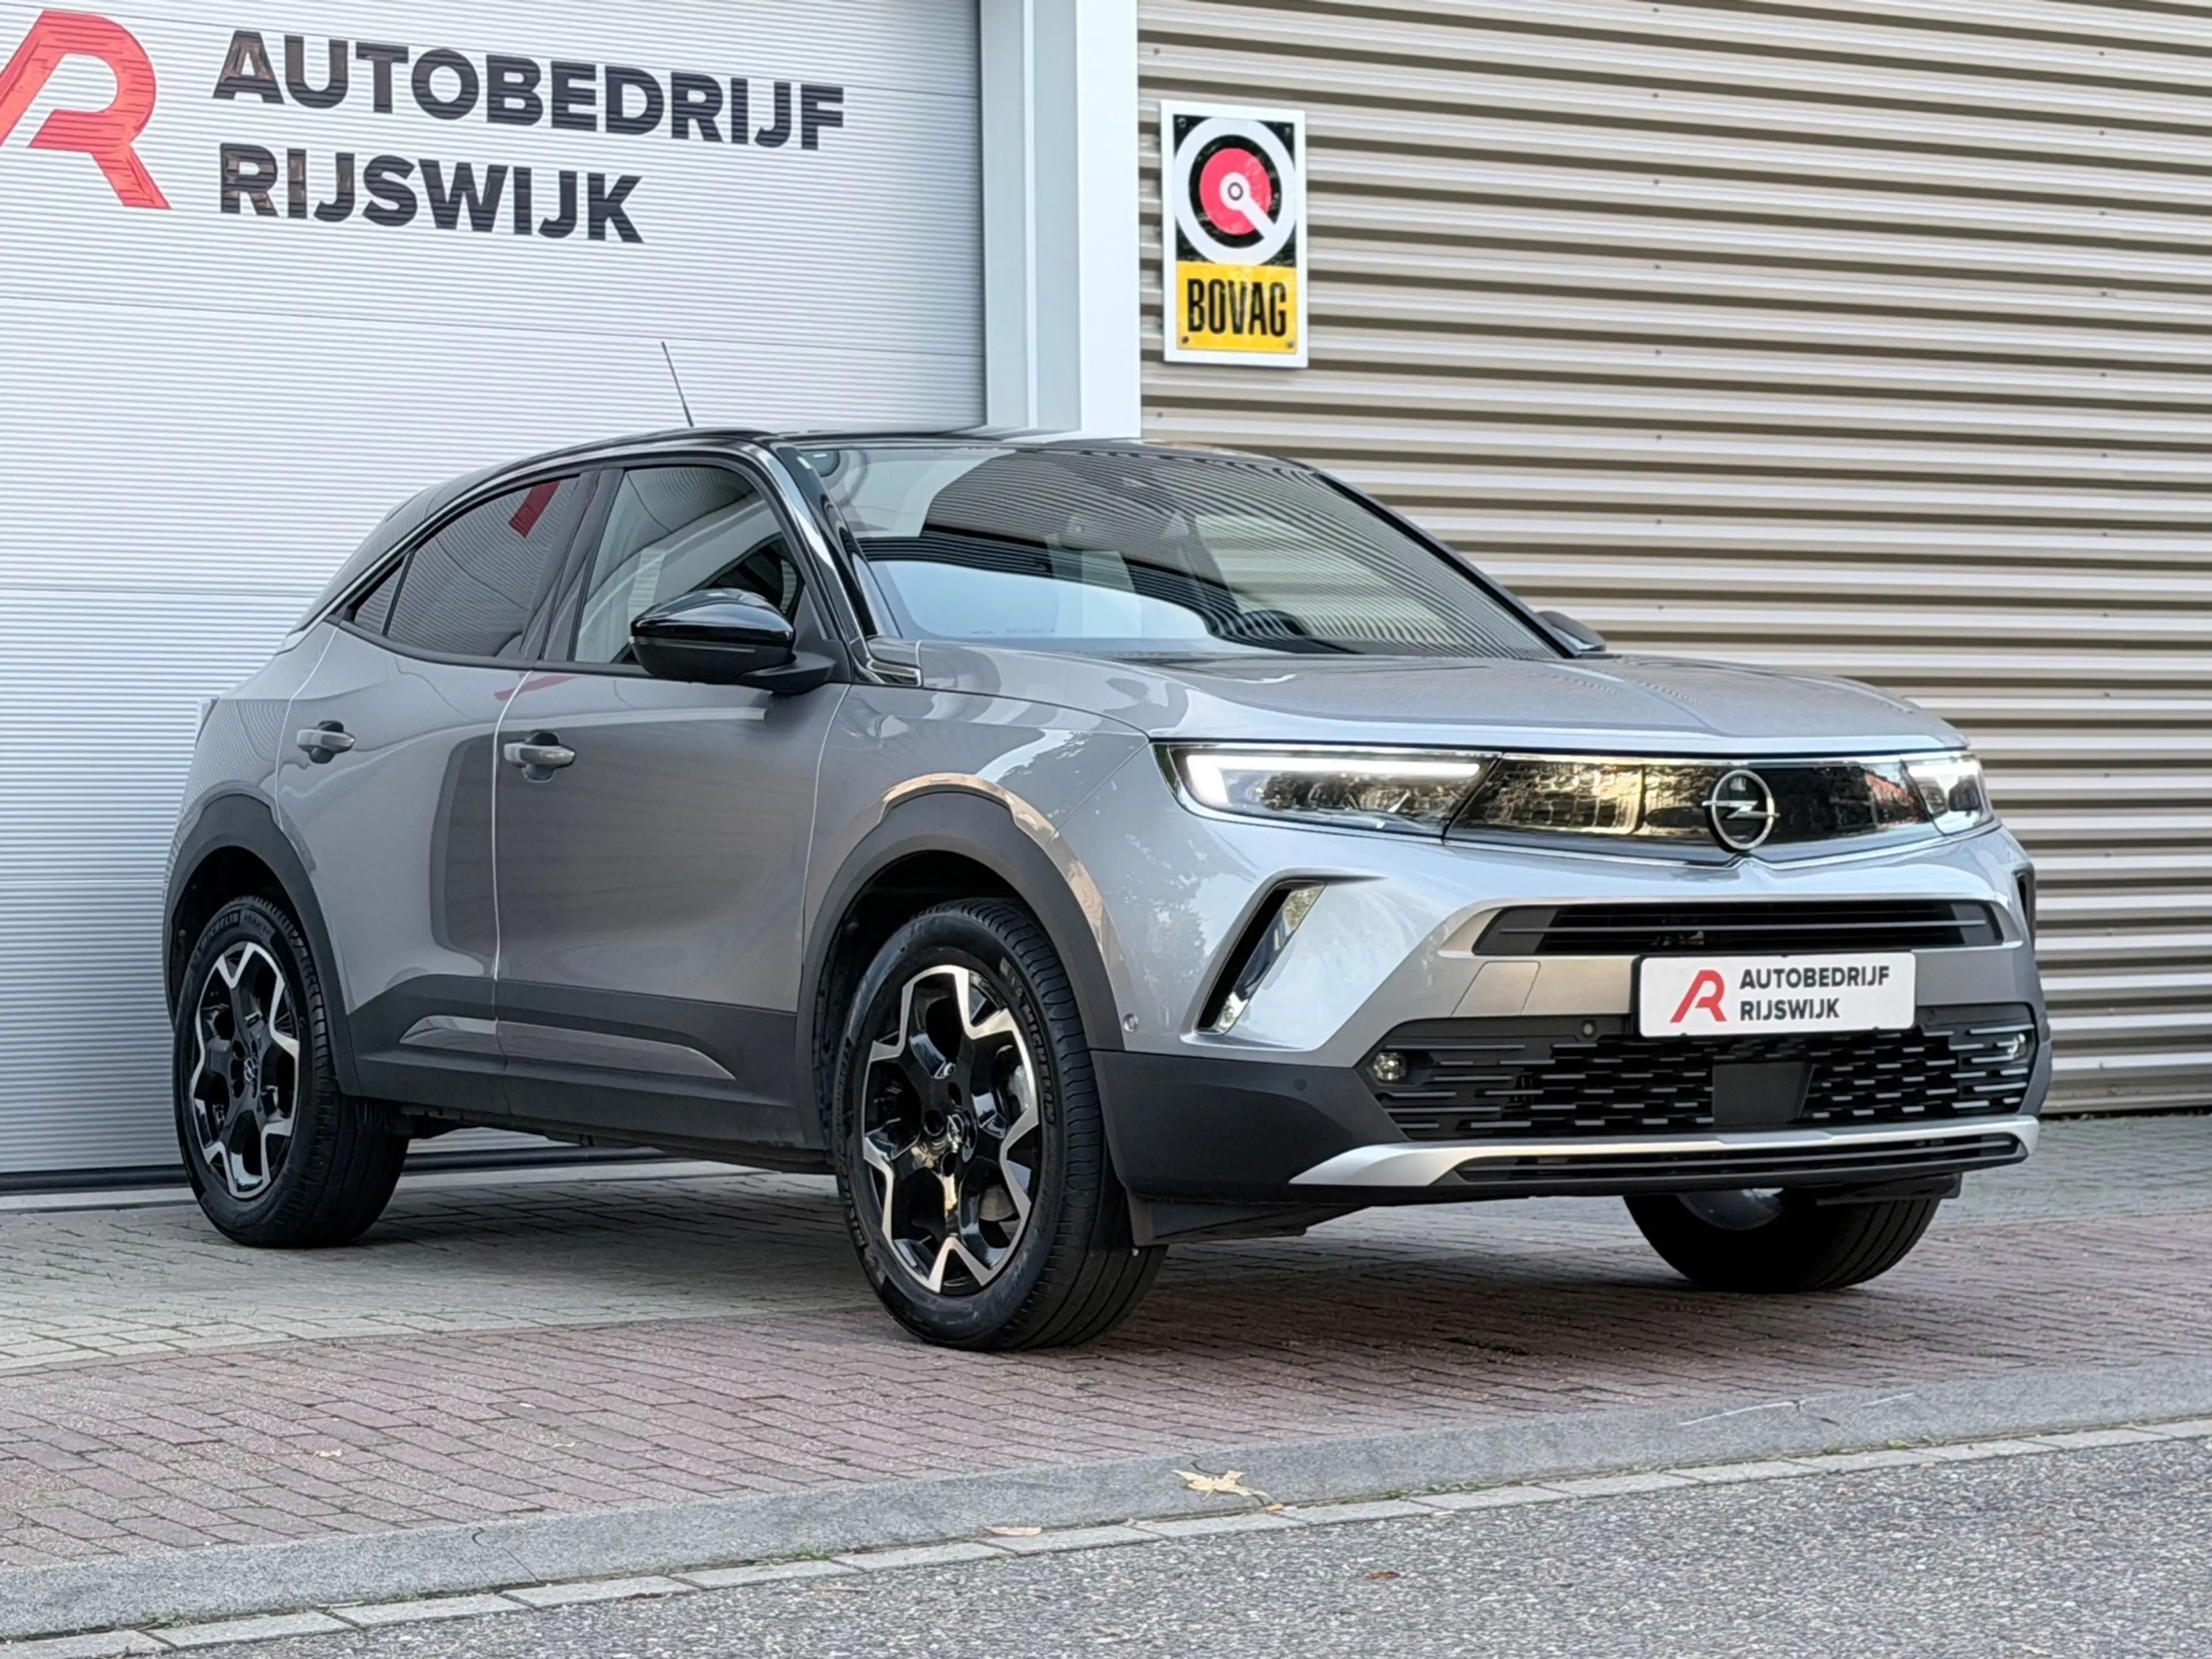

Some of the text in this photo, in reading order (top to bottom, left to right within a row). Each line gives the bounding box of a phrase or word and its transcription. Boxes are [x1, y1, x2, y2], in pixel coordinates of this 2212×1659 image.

[212, 30, 843, 150] AUTOBEDRIJF
[220, 143, 644, 244] RIJSWIJK
[1187, 278, 1287, 337] BOVAG
[1739, 966, 1890, 990] AUTOBEDRIJF
[1740, 998, 1840, 1021] RIJSWIJK
